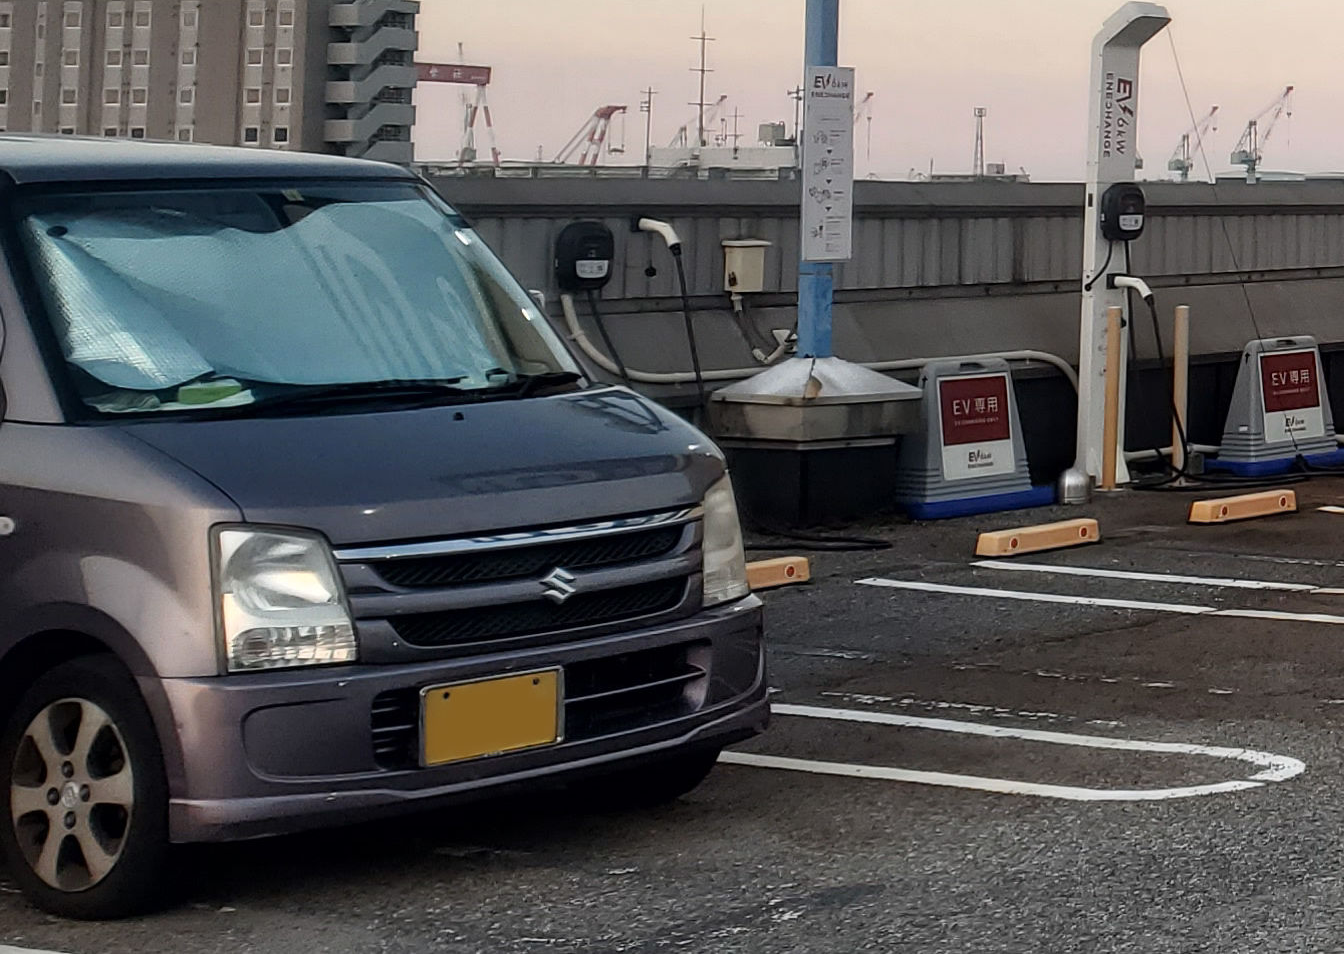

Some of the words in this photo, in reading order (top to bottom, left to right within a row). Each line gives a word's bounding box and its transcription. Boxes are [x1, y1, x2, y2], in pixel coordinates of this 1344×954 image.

[813, 73, 832, 90] EV
[1115, 77, 1134, 117] EV
[1115, 117, 1130, 155] 6kW
[1271, 371, 1288, 386] EV
[952, 398, 971, 416] EV
[974, 396, 998, 414] 専用
[968, 449, 981, 462] EV
